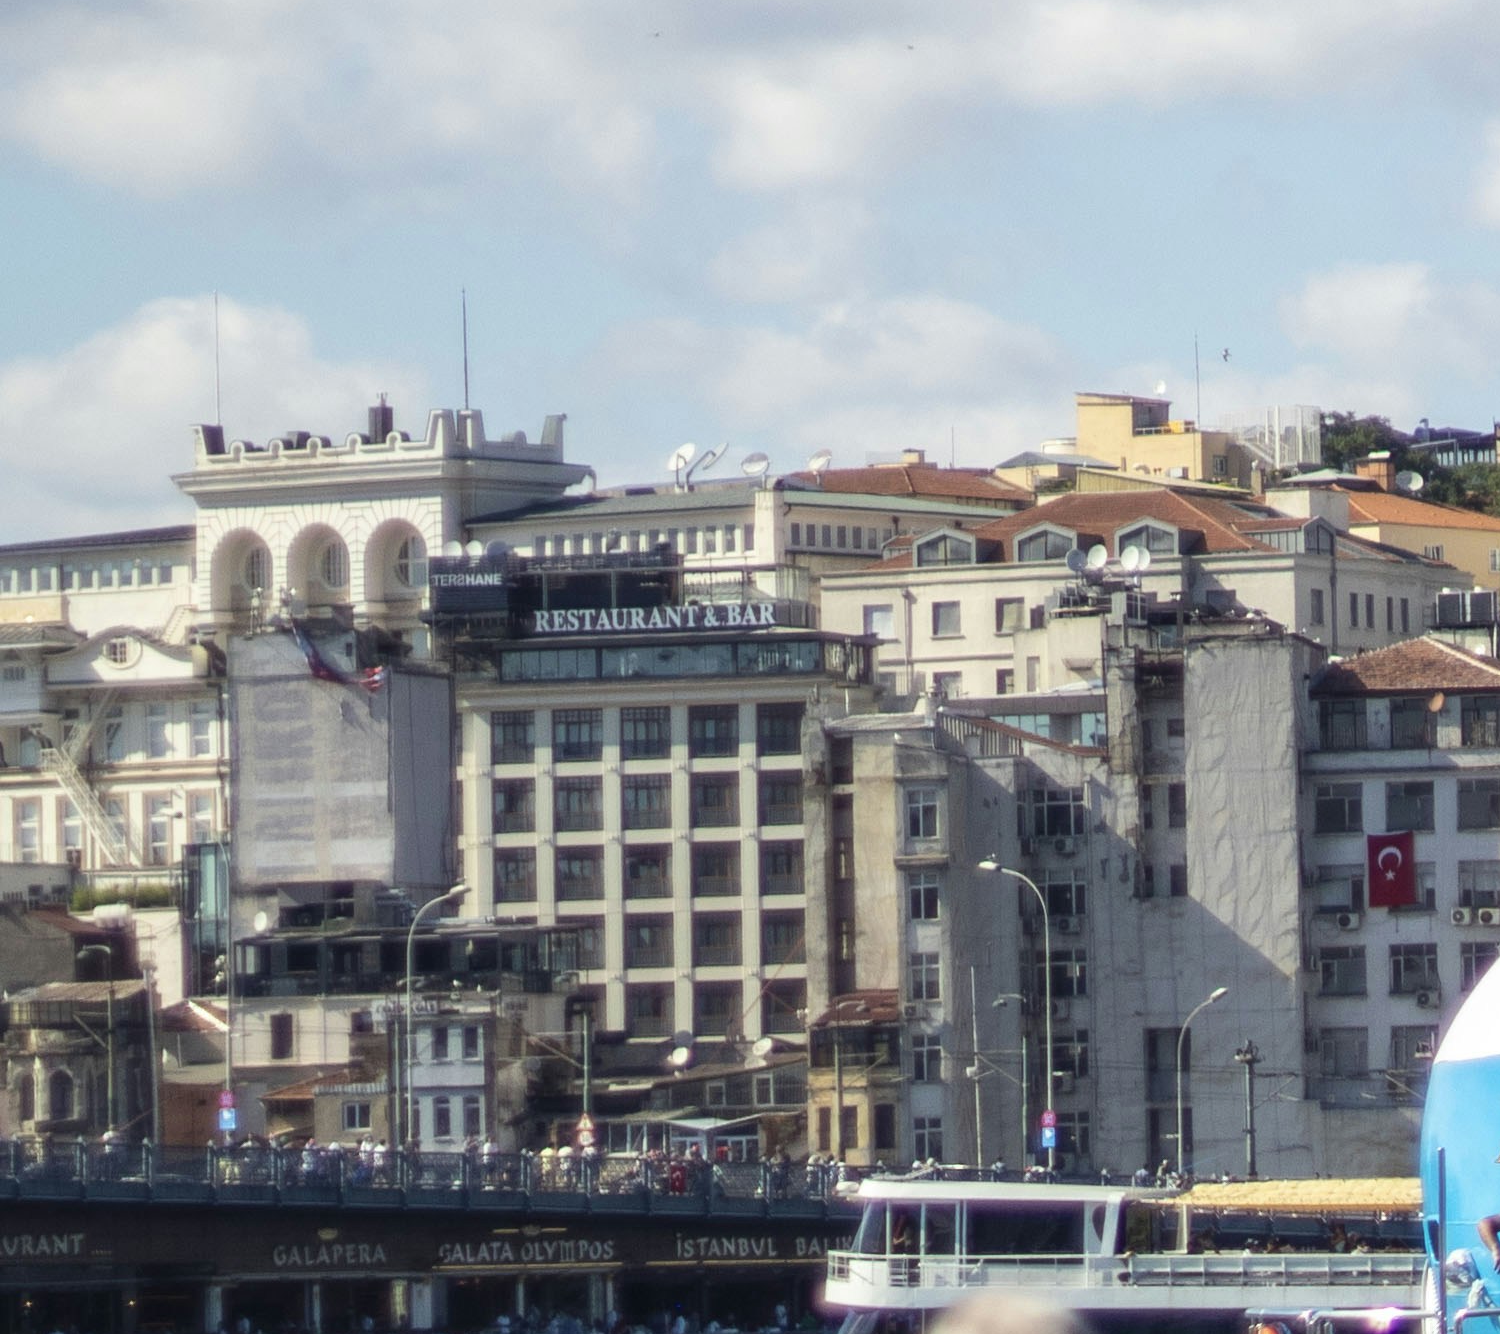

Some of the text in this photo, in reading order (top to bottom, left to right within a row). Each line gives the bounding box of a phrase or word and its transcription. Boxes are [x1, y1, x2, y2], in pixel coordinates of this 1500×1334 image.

[534, 602, 776, 633] RESTAURANT & BAR
[0, 1232, 85, 1256] URANT
[273, 1242, 387, 1266] GALAPERA
